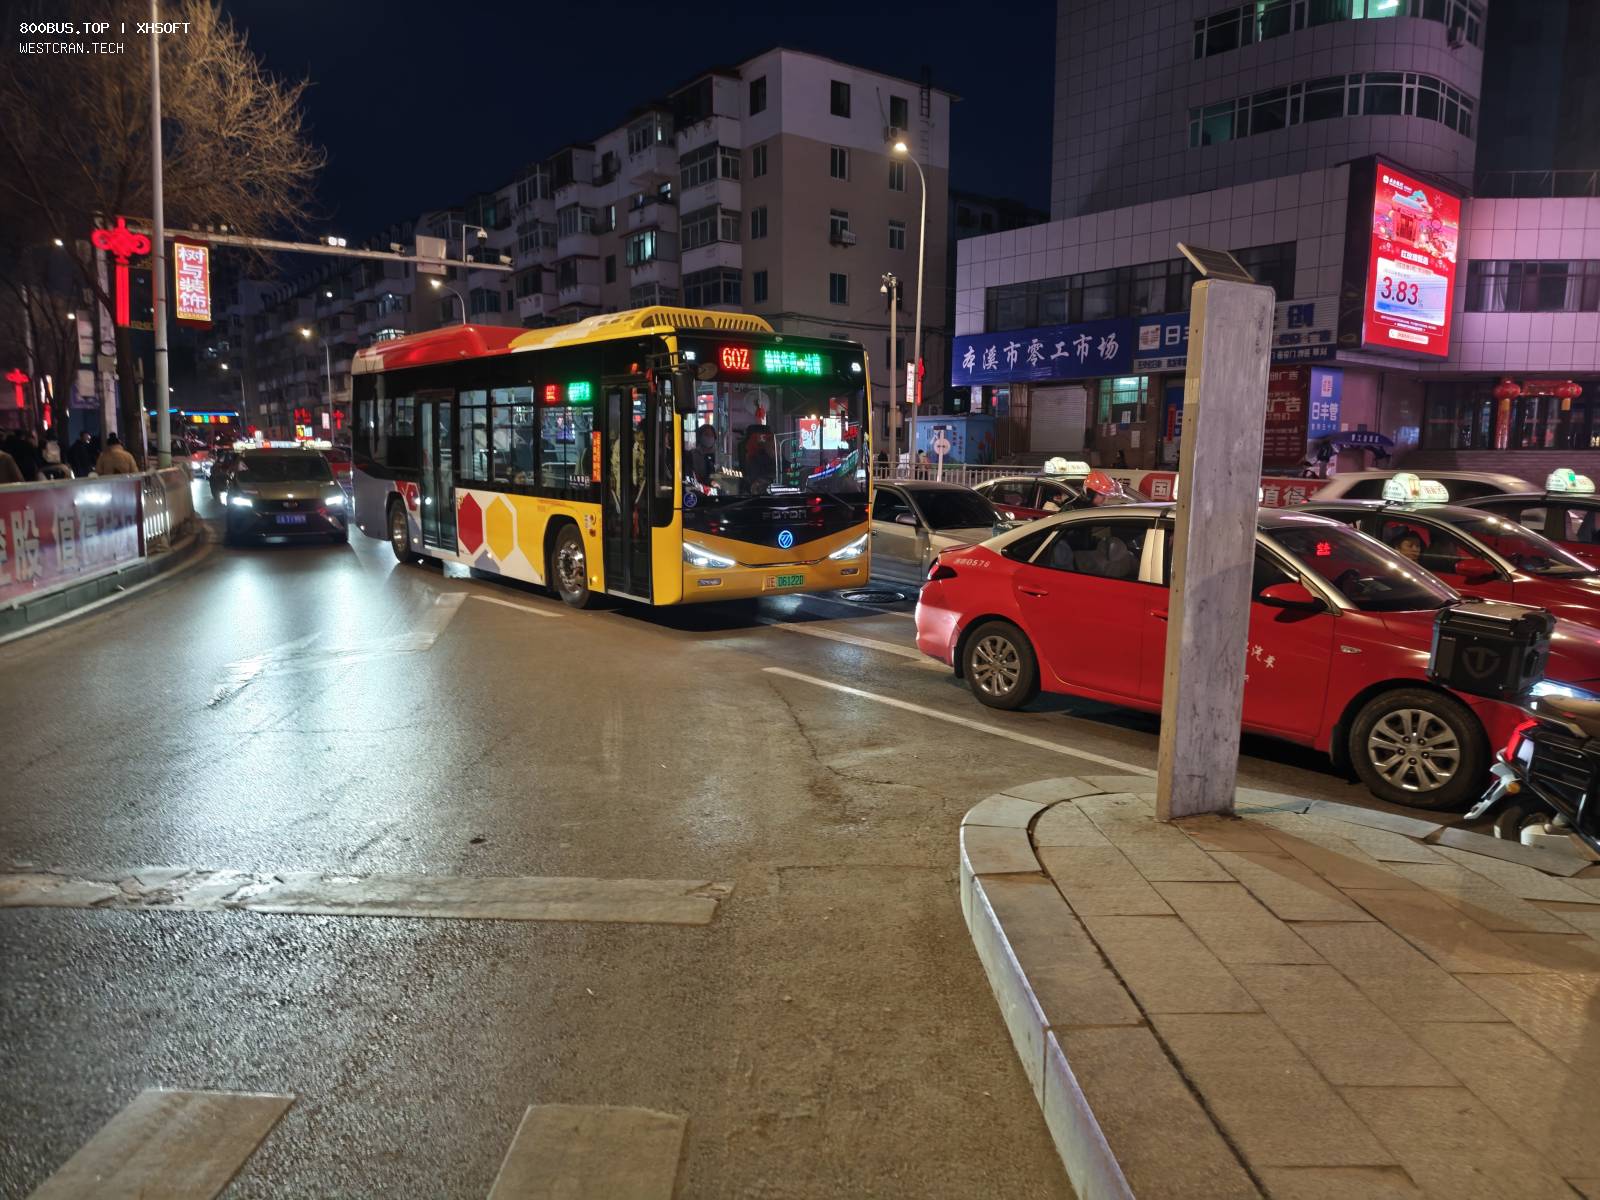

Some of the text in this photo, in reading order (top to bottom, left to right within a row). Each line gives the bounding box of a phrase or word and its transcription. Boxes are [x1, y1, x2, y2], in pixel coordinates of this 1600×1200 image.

[962, 332, 1119, 374] 本溪市零工市场
